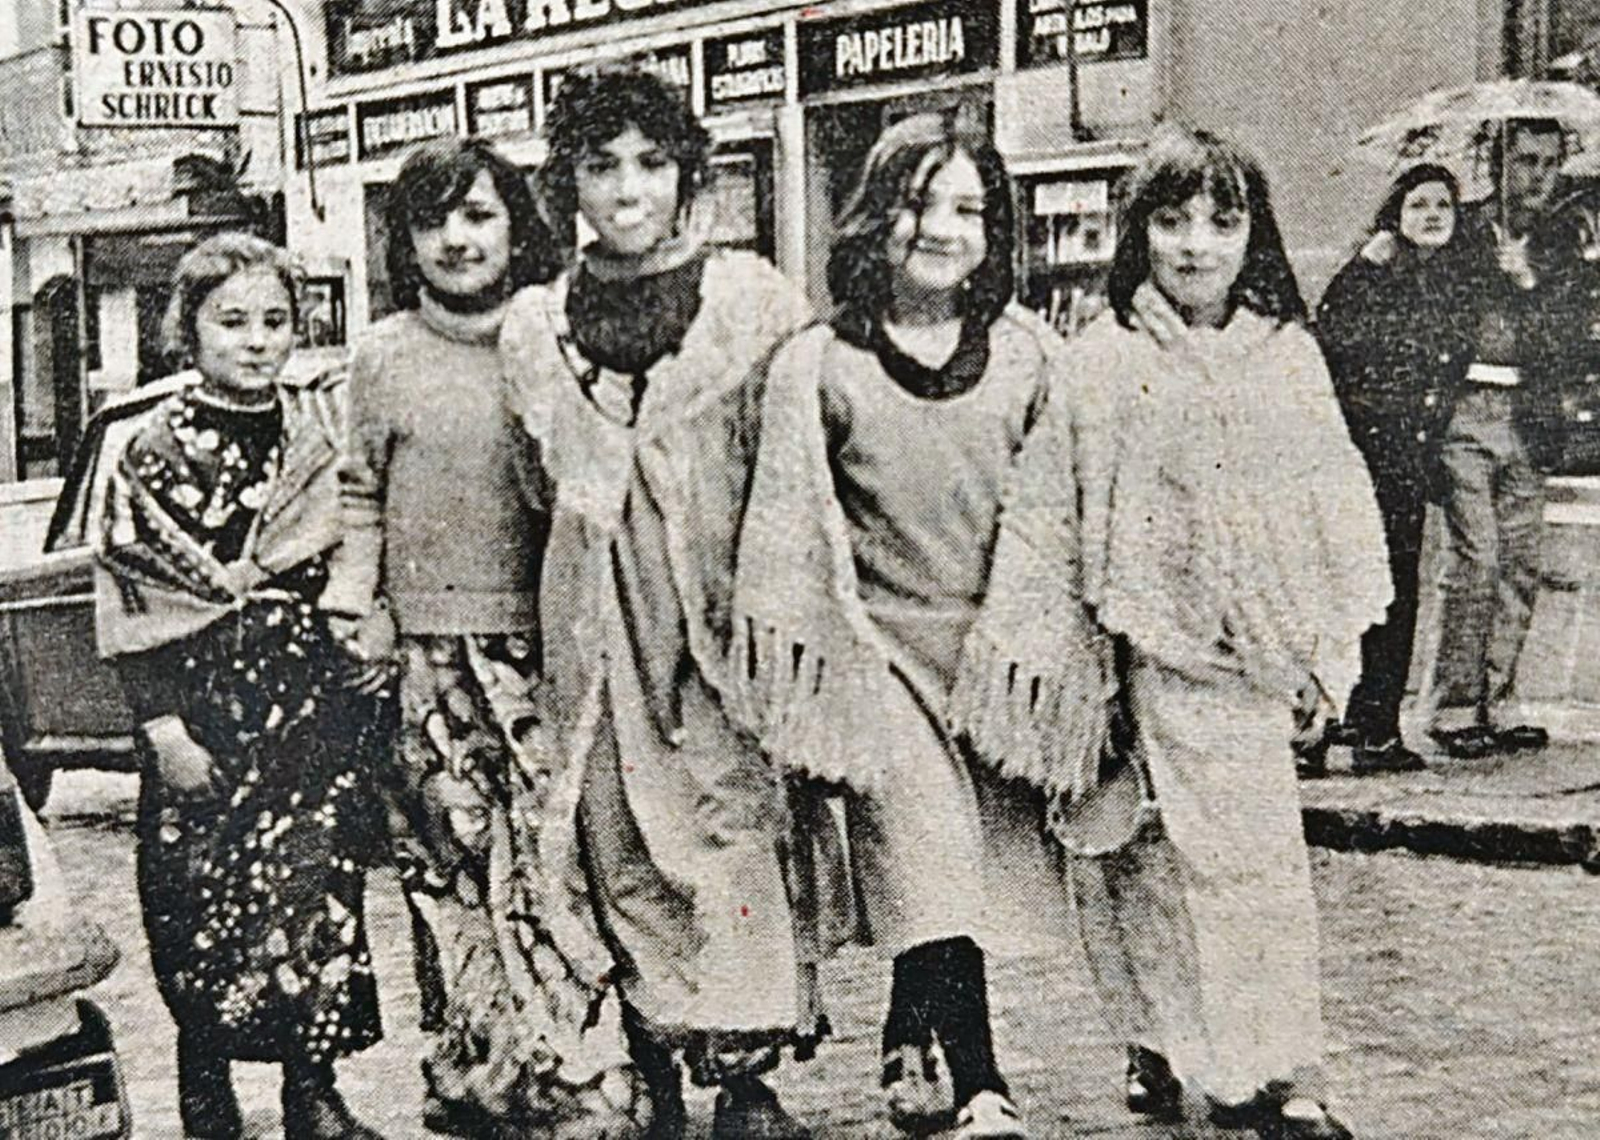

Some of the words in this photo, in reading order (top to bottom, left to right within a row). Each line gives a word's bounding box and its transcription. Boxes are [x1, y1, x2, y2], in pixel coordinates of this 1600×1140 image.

[88, 17, 204, 56] FOTO
[836, 16, 965, 78] PAPELERIA
[124, 60, 232, 88] ERNESTO
[102, 93, 217, 119] SCHRECK
